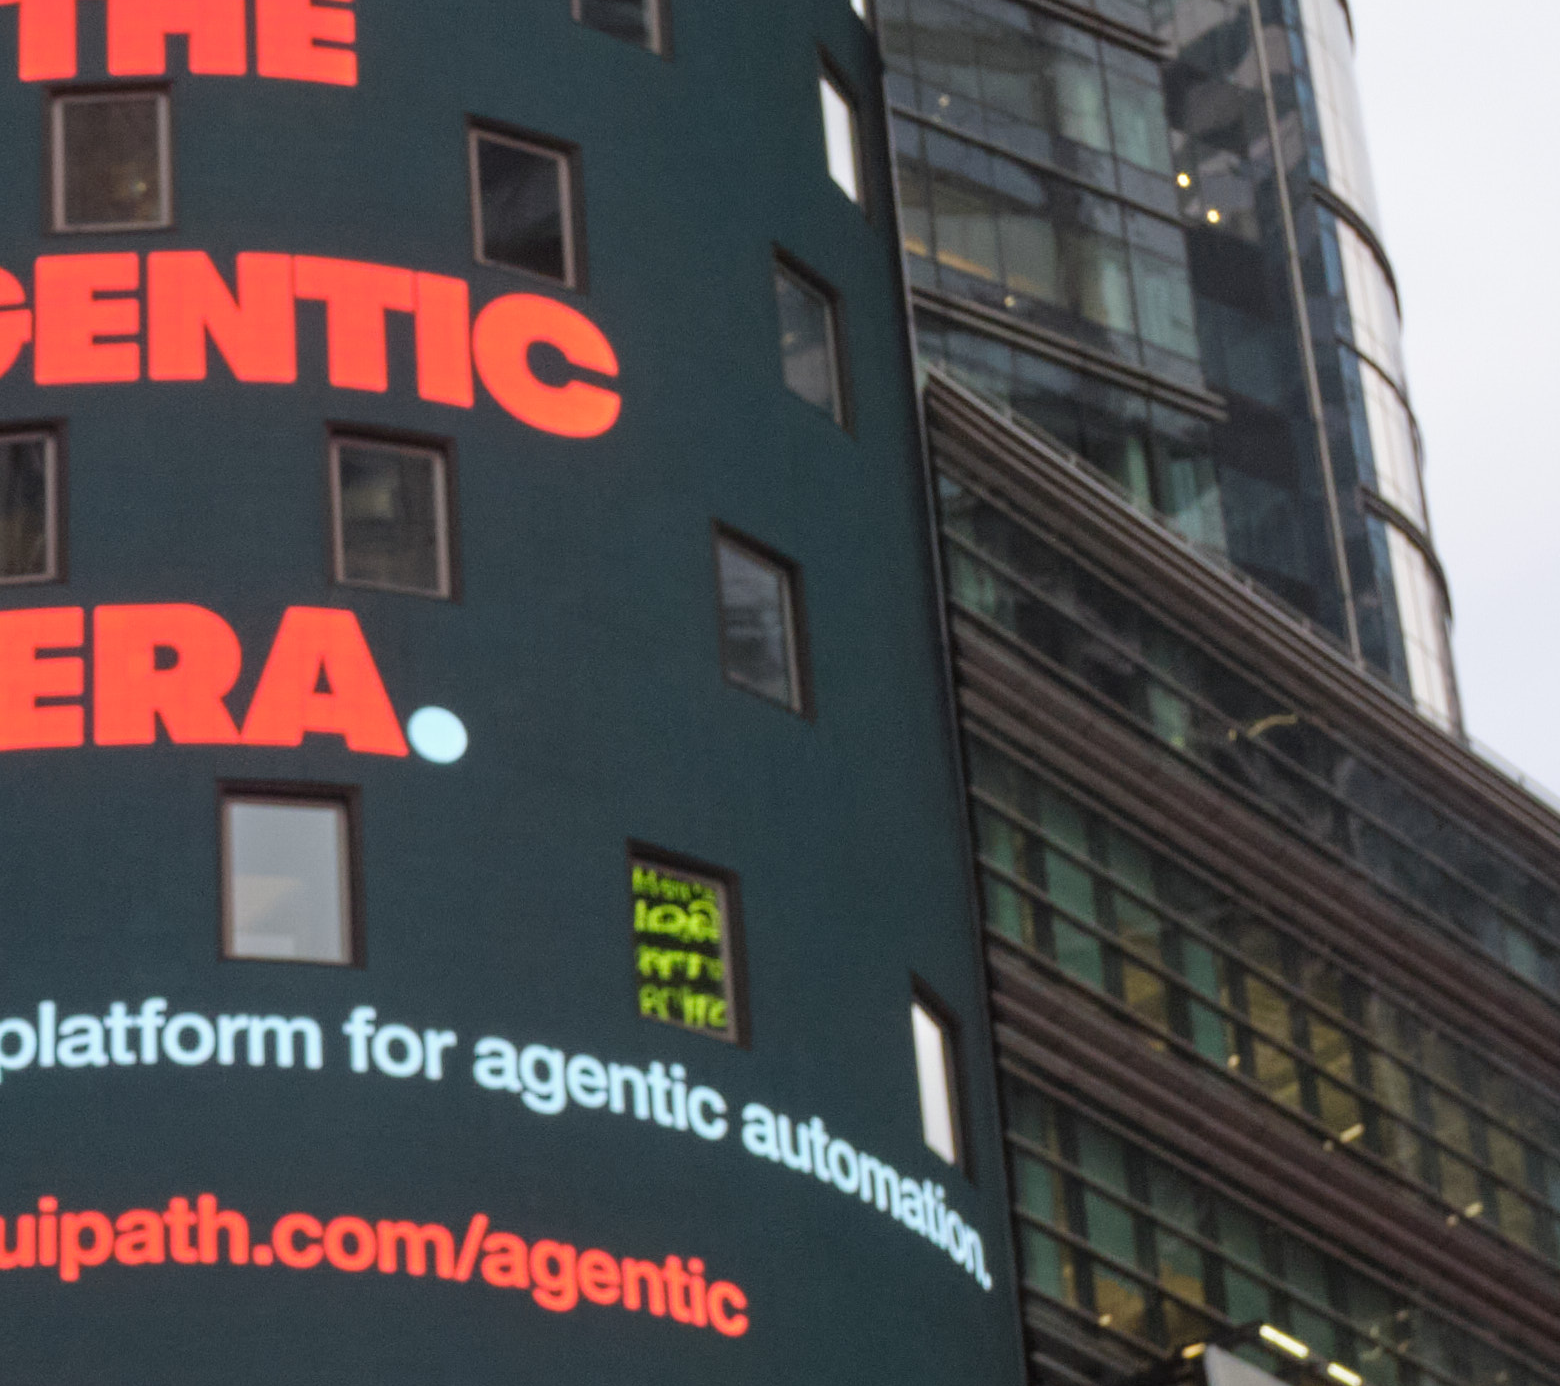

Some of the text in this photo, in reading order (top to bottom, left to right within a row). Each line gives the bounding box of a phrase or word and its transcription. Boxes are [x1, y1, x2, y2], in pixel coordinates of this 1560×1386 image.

[344, 1006, 456, 1081] for
[474, 1032, 728, 1142] agentic
[741, 1099, 994, 1293] automation.
